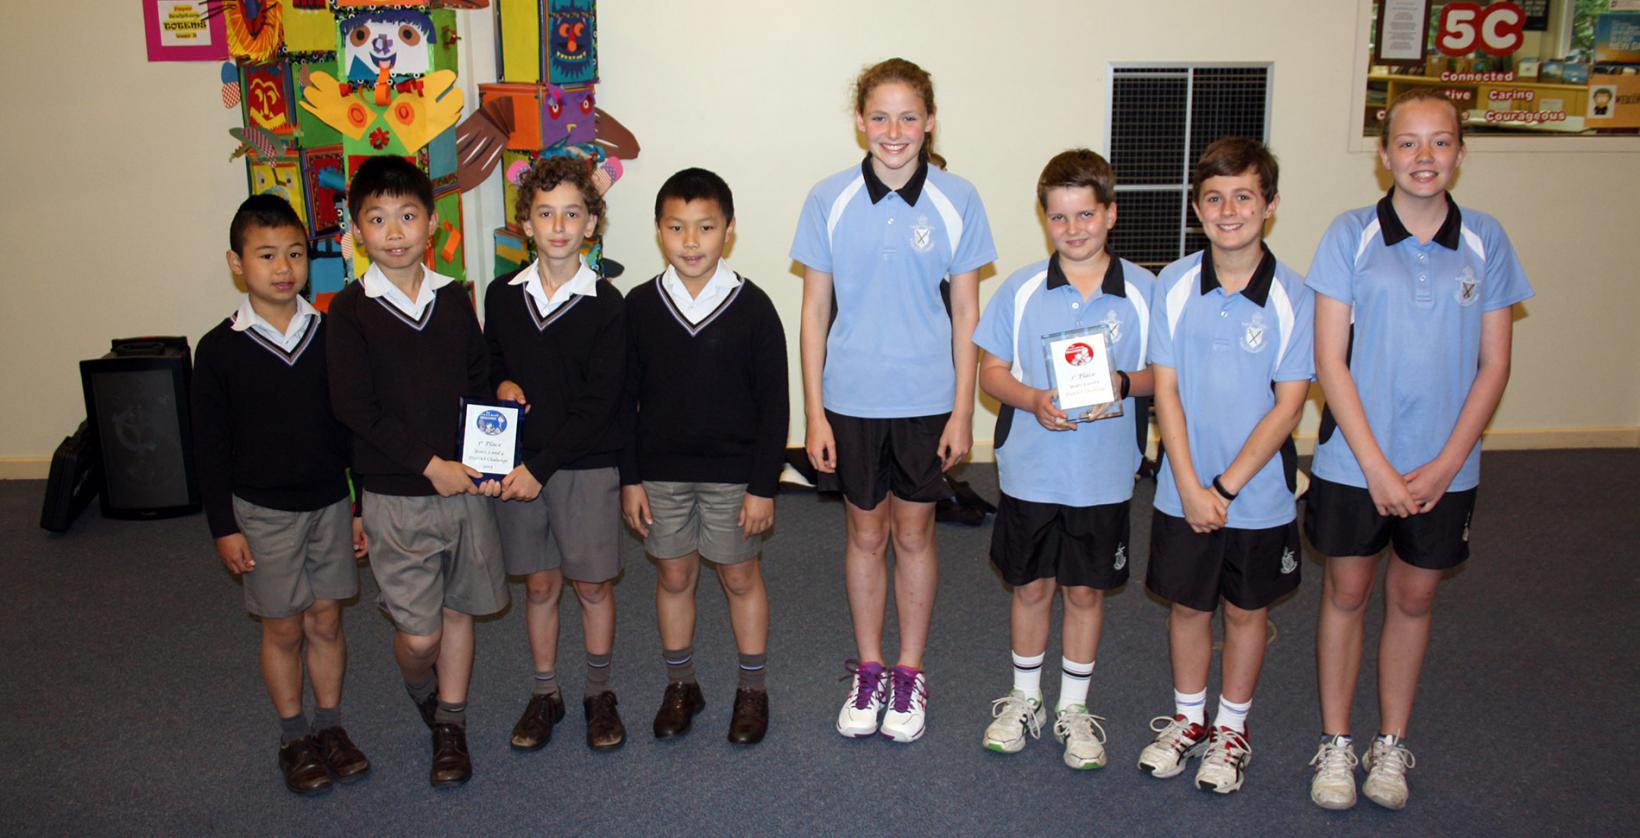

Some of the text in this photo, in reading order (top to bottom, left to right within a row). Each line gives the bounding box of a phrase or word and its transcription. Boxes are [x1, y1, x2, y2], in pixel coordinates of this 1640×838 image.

[1440, 7, 1522, 51] 5C
[1441, 71, 1514, 82] Connected
[1489, 90, 1534, 101] Caring
[1486, 111, 1566, 122] Courageous
